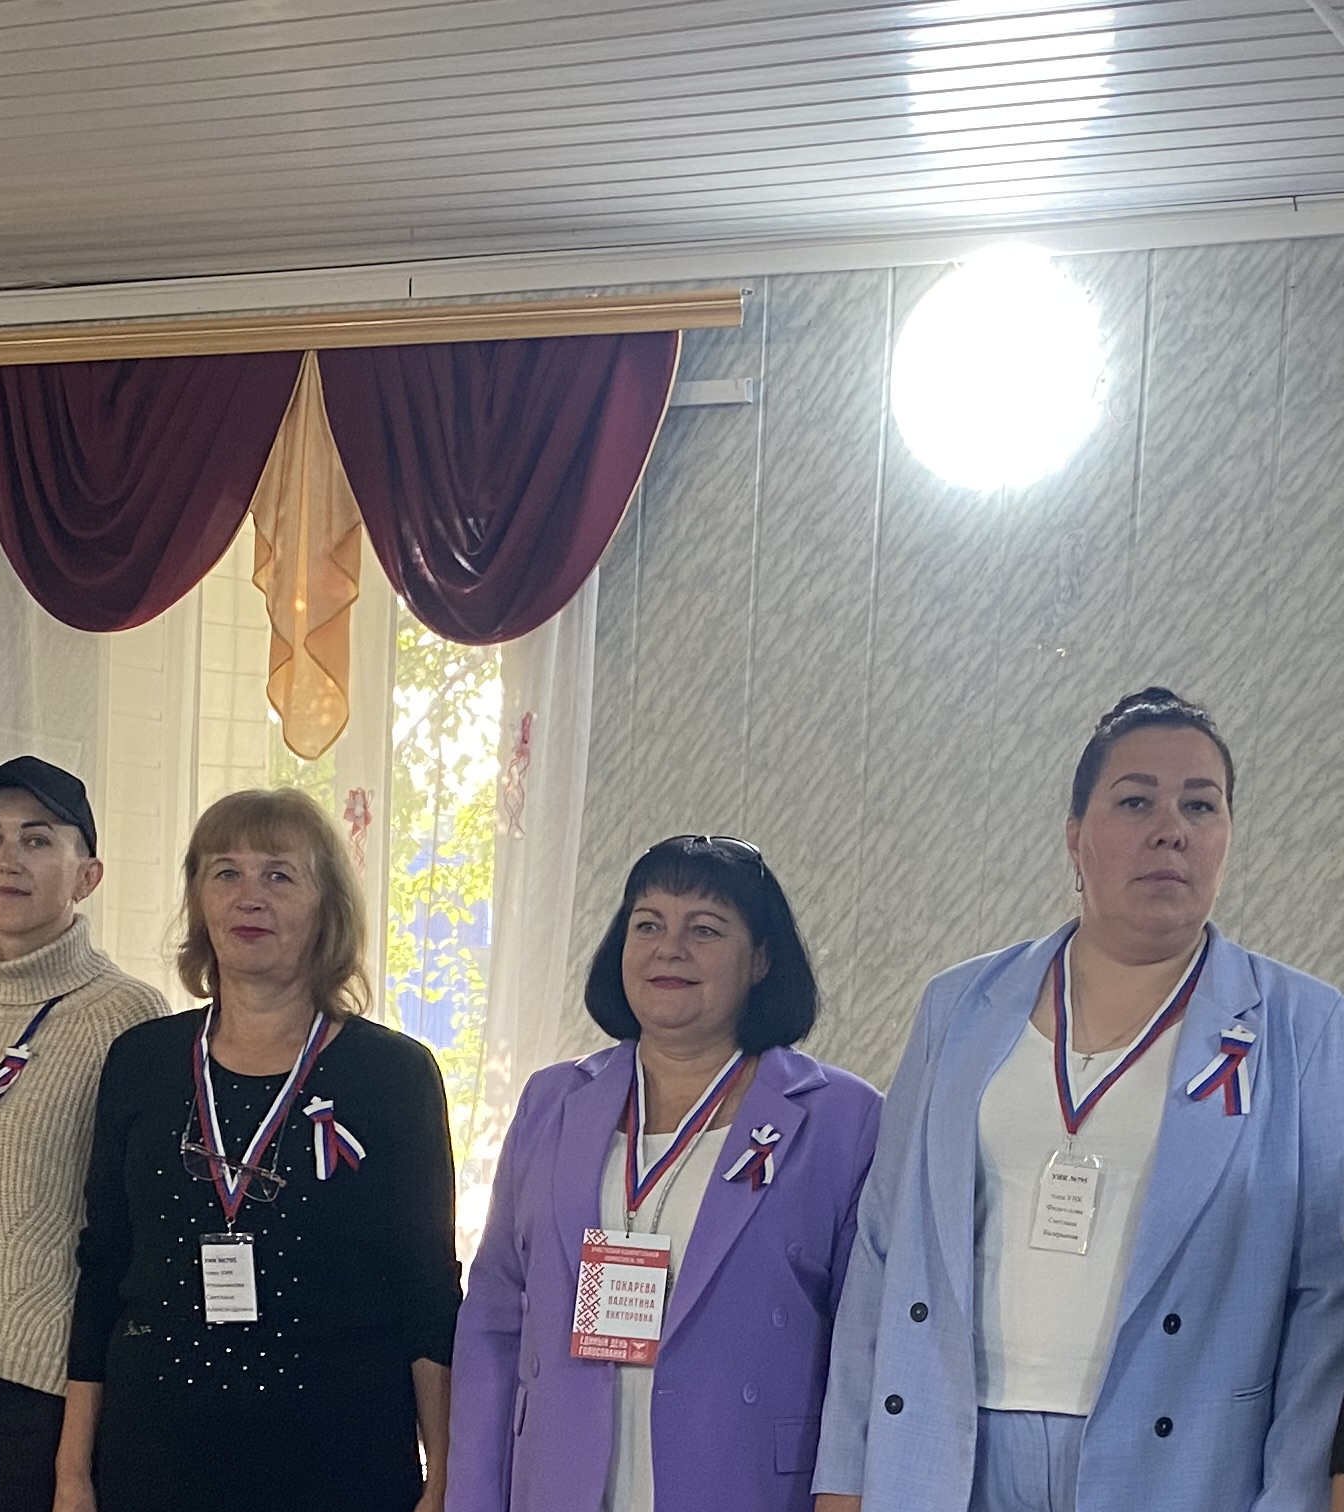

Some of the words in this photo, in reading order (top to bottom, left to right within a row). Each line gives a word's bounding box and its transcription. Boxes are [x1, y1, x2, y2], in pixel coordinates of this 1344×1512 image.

[610, 1279, 657, 1295] ТОКАРЕВА
[607, 1295, 655, 1309] ВАЛЕНТИНА
[605, 1309, 653, 1323] ВИКТОРОВНА
[580, 1335, 609, 1348] ЕДИНЫЙ
[609, 1338, 628, 1349] ДЕНЬ
[578, 1345, 627, 1360] ГОЛОСОВАНИЯ
